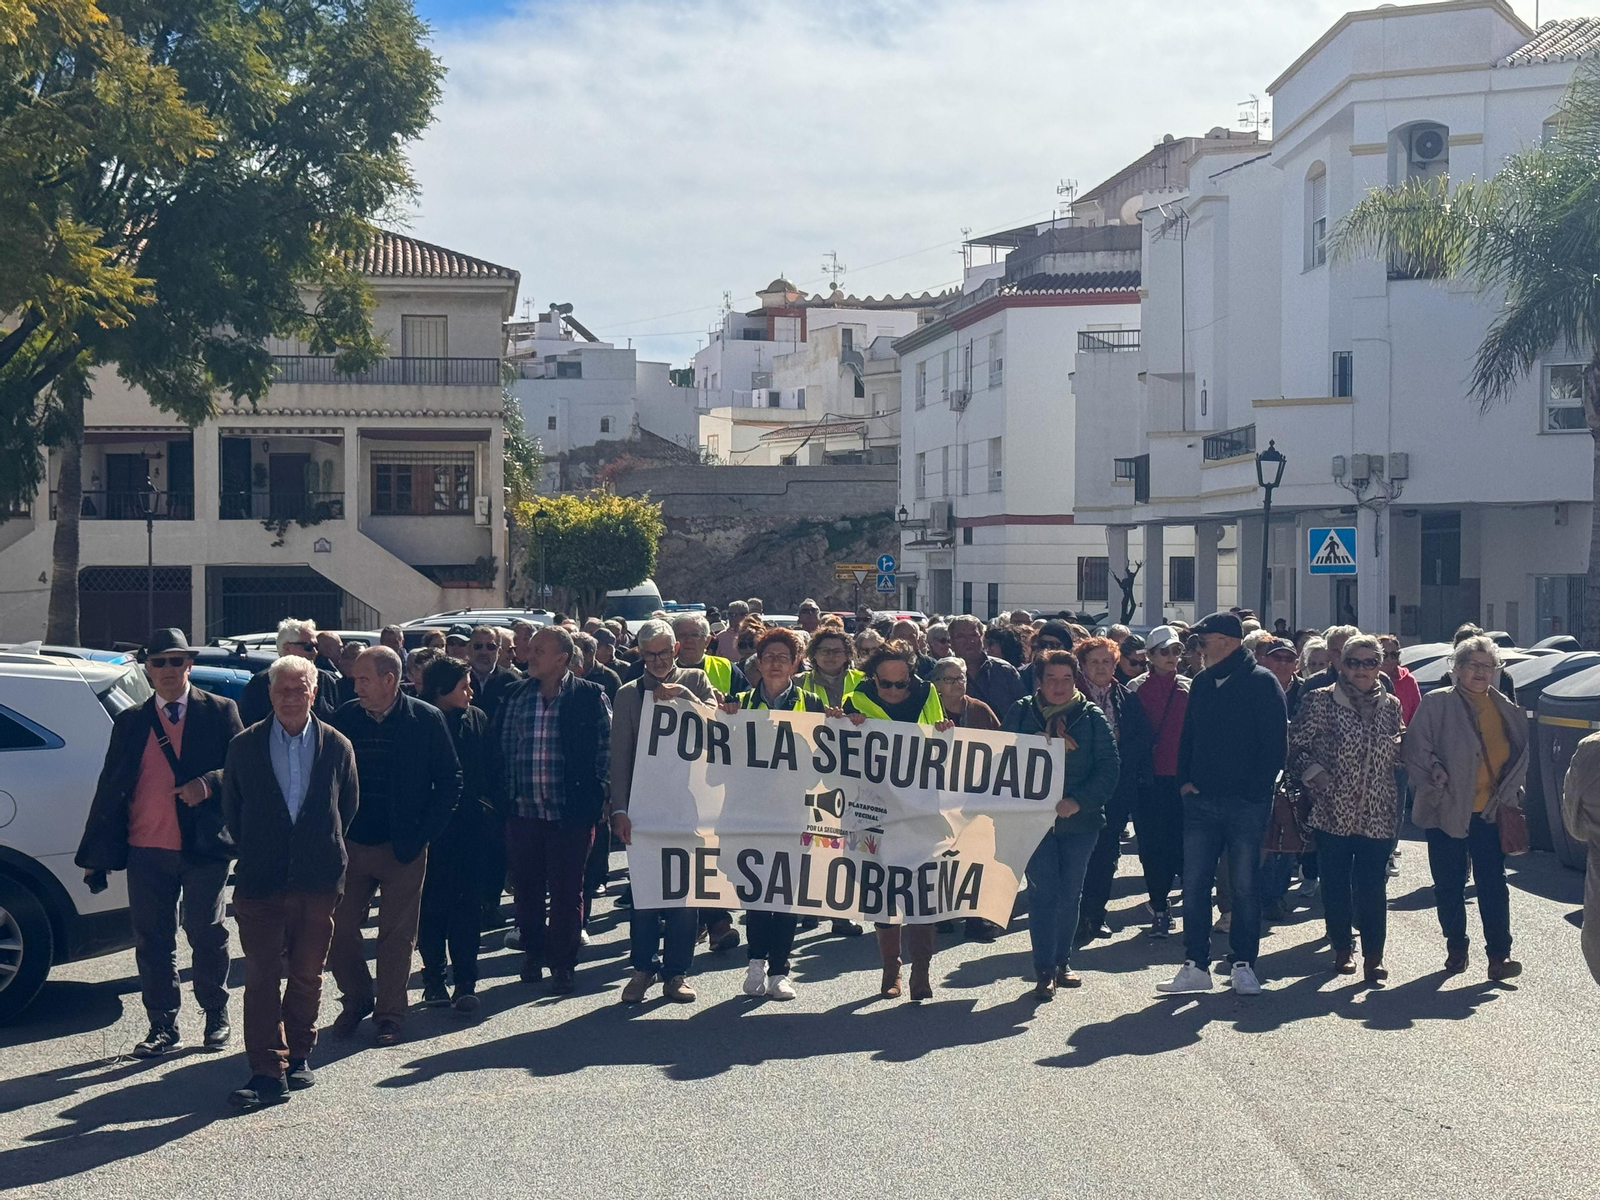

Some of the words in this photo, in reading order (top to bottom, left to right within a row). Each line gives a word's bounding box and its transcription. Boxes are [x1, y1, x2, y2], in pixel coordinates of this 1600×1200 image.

[38, 571, 48, 584] 4
[647, 704, 731, 766] POR
[746, 720, 798, 771] LA
[812, 724, 1053, 801] SEGURIDAD
[848, 801, 888, 815] PLATAFORMA
[854, 811, 879, 822] VECINAL
[661, 847, 721, 901] DE
[736, 848, 984, 918] SALOBREÑA
